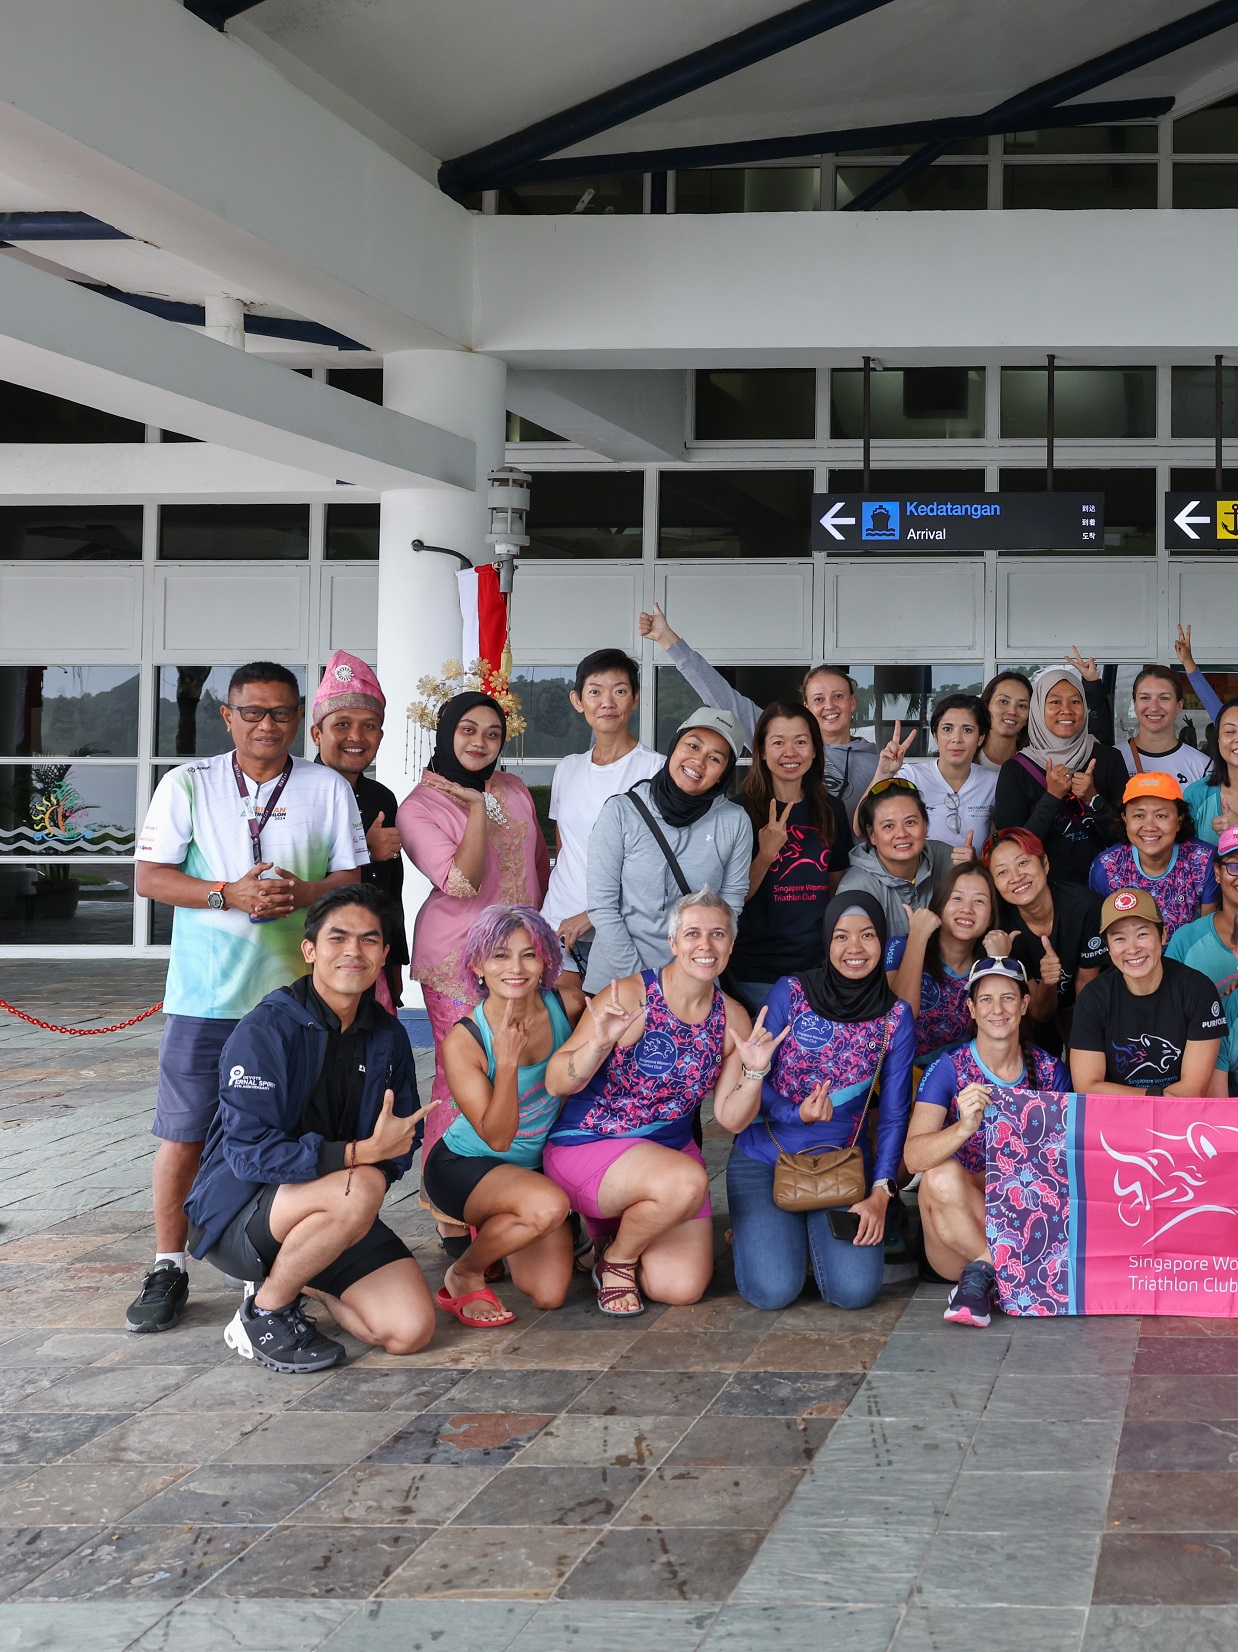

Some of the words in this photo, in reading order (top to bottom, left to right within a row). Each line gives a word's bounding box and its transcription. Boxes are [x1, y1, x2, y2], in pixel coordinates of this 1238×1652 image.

[906, 502, 1000, 519] Kedatangan
[907, 528, 946, 540] Arrival
[917, 1059, 941, 1093] PURPOSE
[1128, 1255, 1209, 1274] Singapore
[1128, 1275, 1199, 1292] Triathlon
[1203, 1277, 1238, 1293] Club
